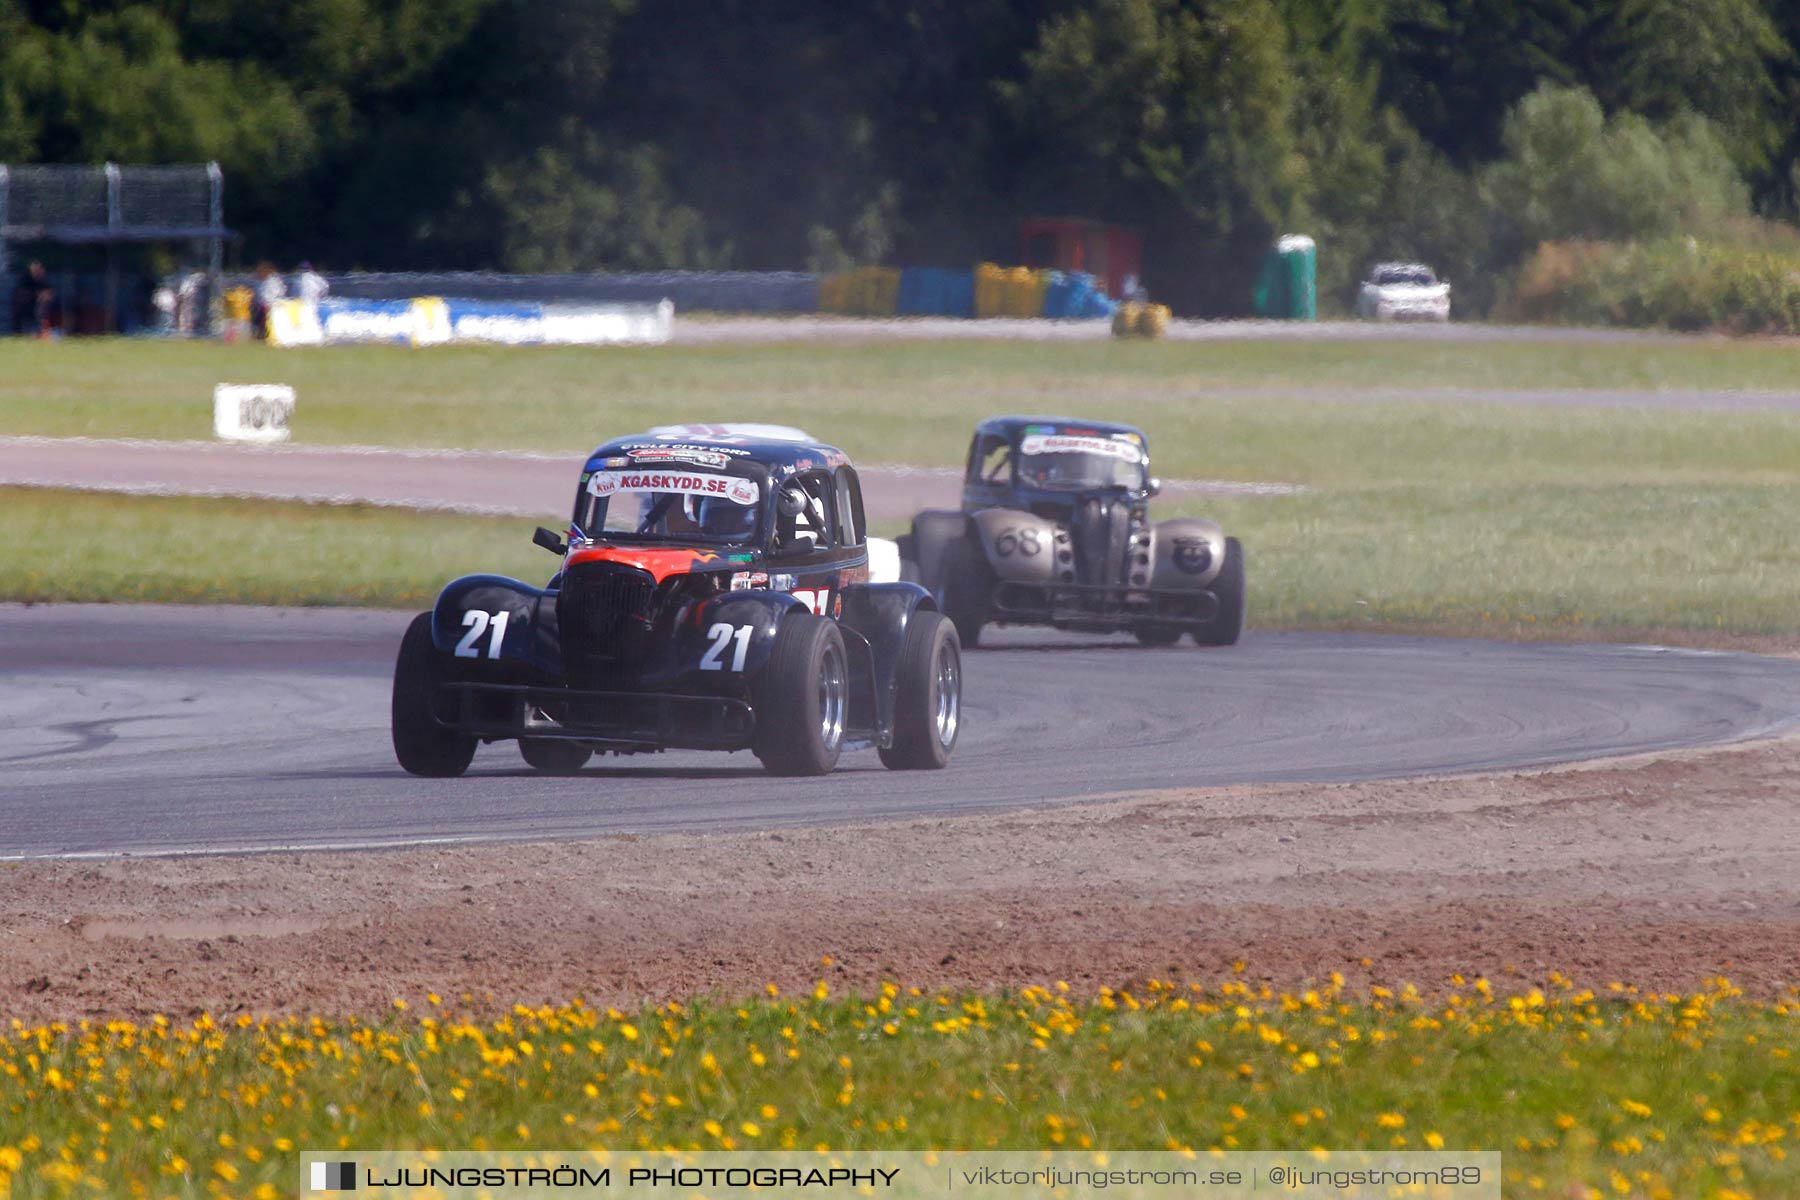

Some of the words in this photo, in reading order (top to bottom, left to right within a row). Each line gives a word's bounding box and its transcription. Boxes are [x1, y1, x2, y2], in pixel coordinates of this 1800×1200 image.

[671, 443, 708, 451] CITY
[709, 446, 751, 456] CORP
[620, 475, 728, 493] KGASKYDD.SE
[995, 527, 1041, 557] 68
[454, 609, 510, 660] 21
[700, 622, 754, 672] 21
